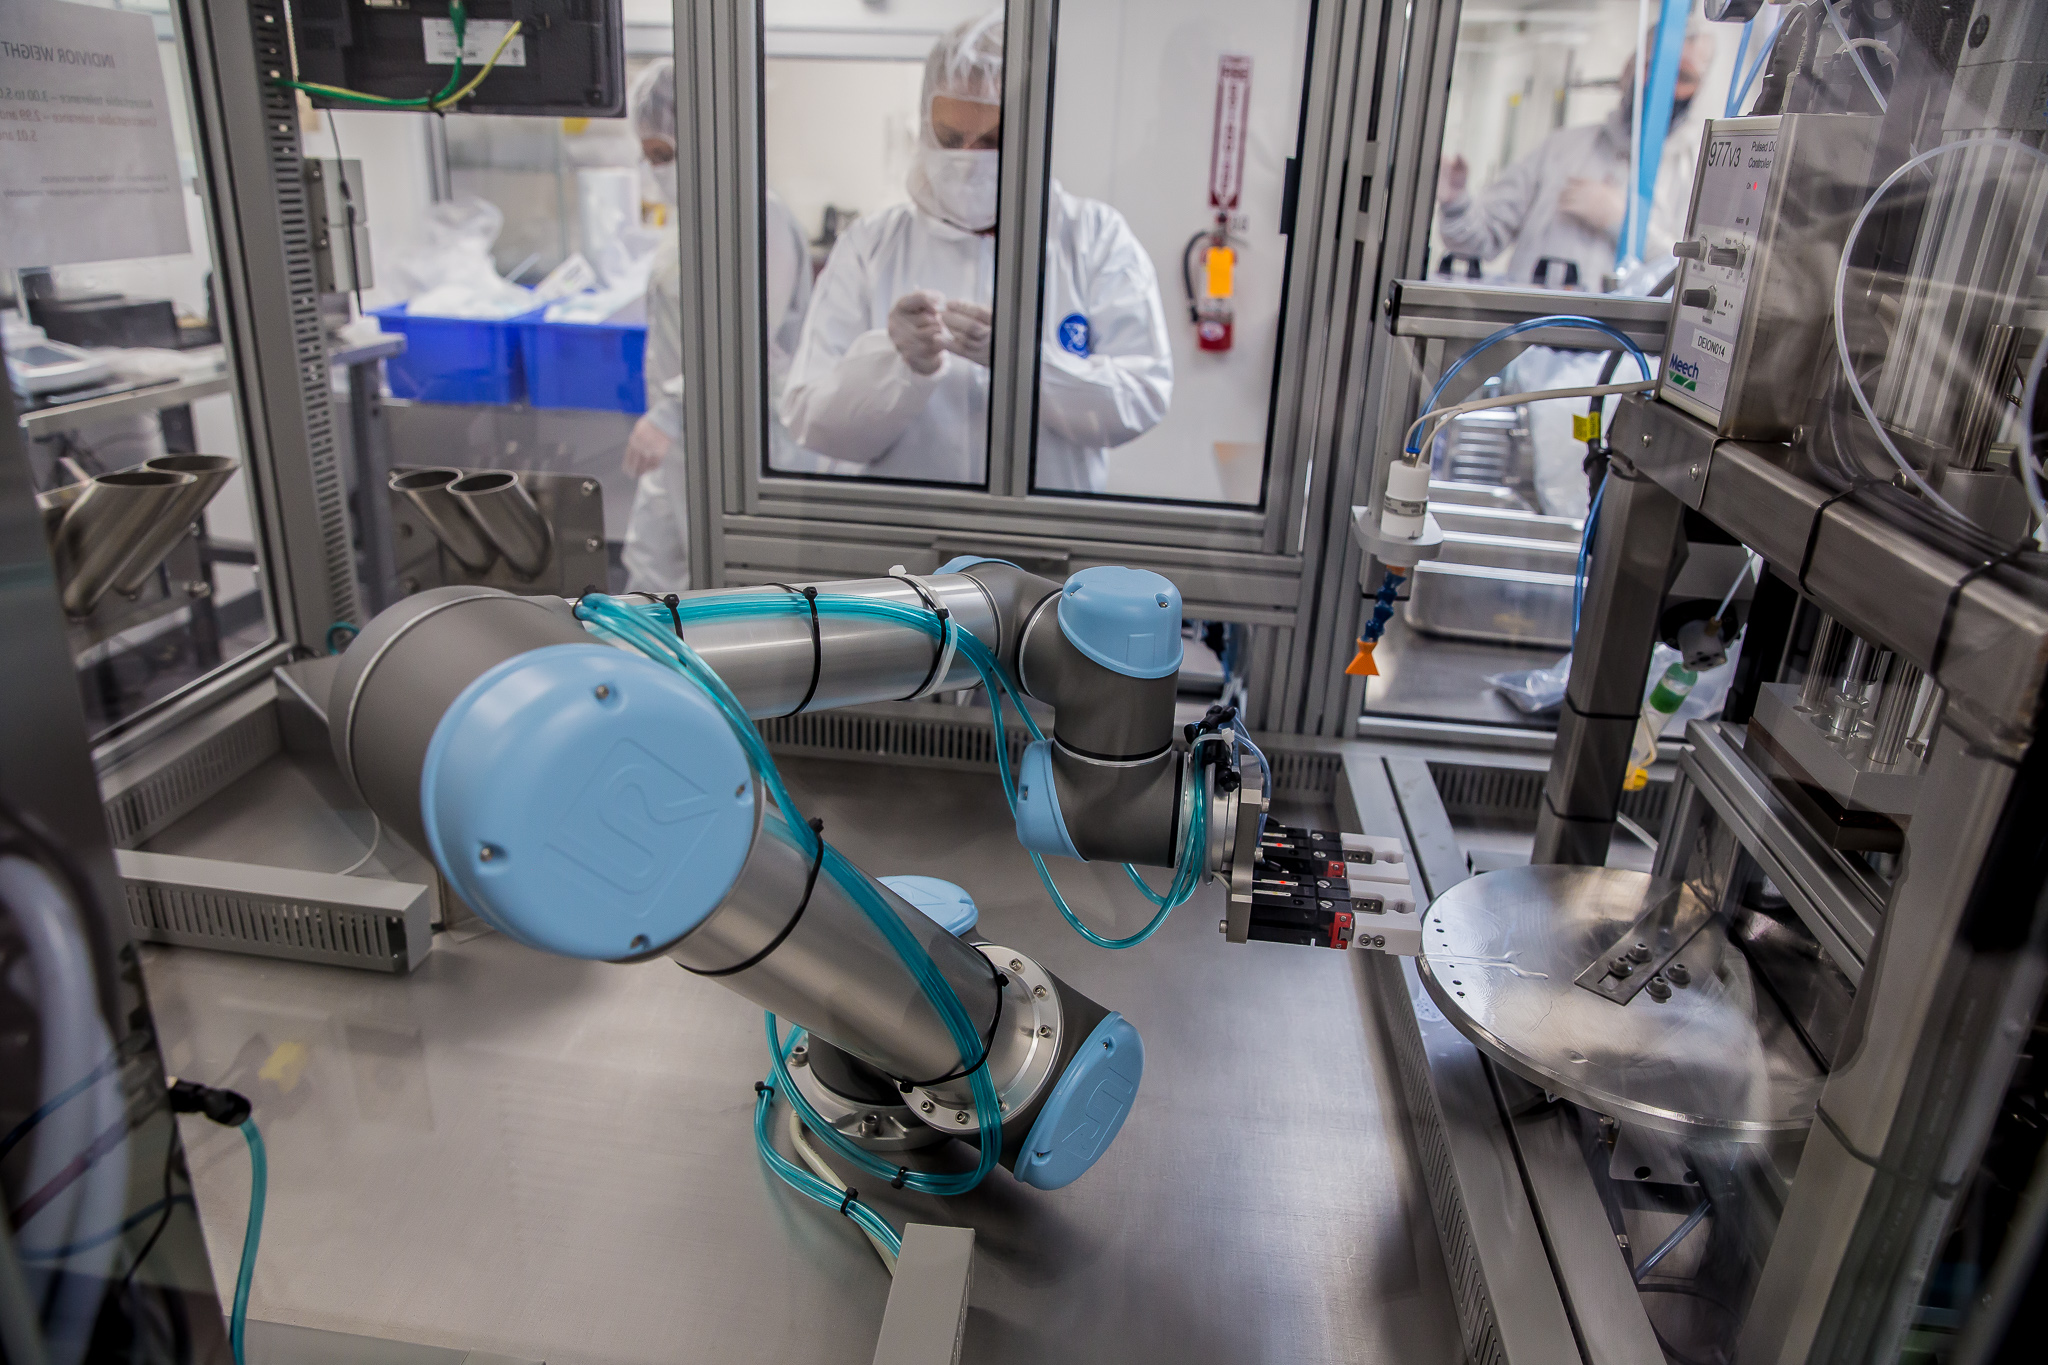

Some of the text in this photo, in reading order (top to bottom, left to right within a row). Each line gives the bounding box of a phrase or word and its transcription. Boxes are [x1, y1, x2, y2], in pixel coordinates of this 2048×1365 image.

[1751, 140, 1769, 152] Pulsed
[1748, 156, 1772, 168] Controller
[1669, 353, 1699, 380] Meech
